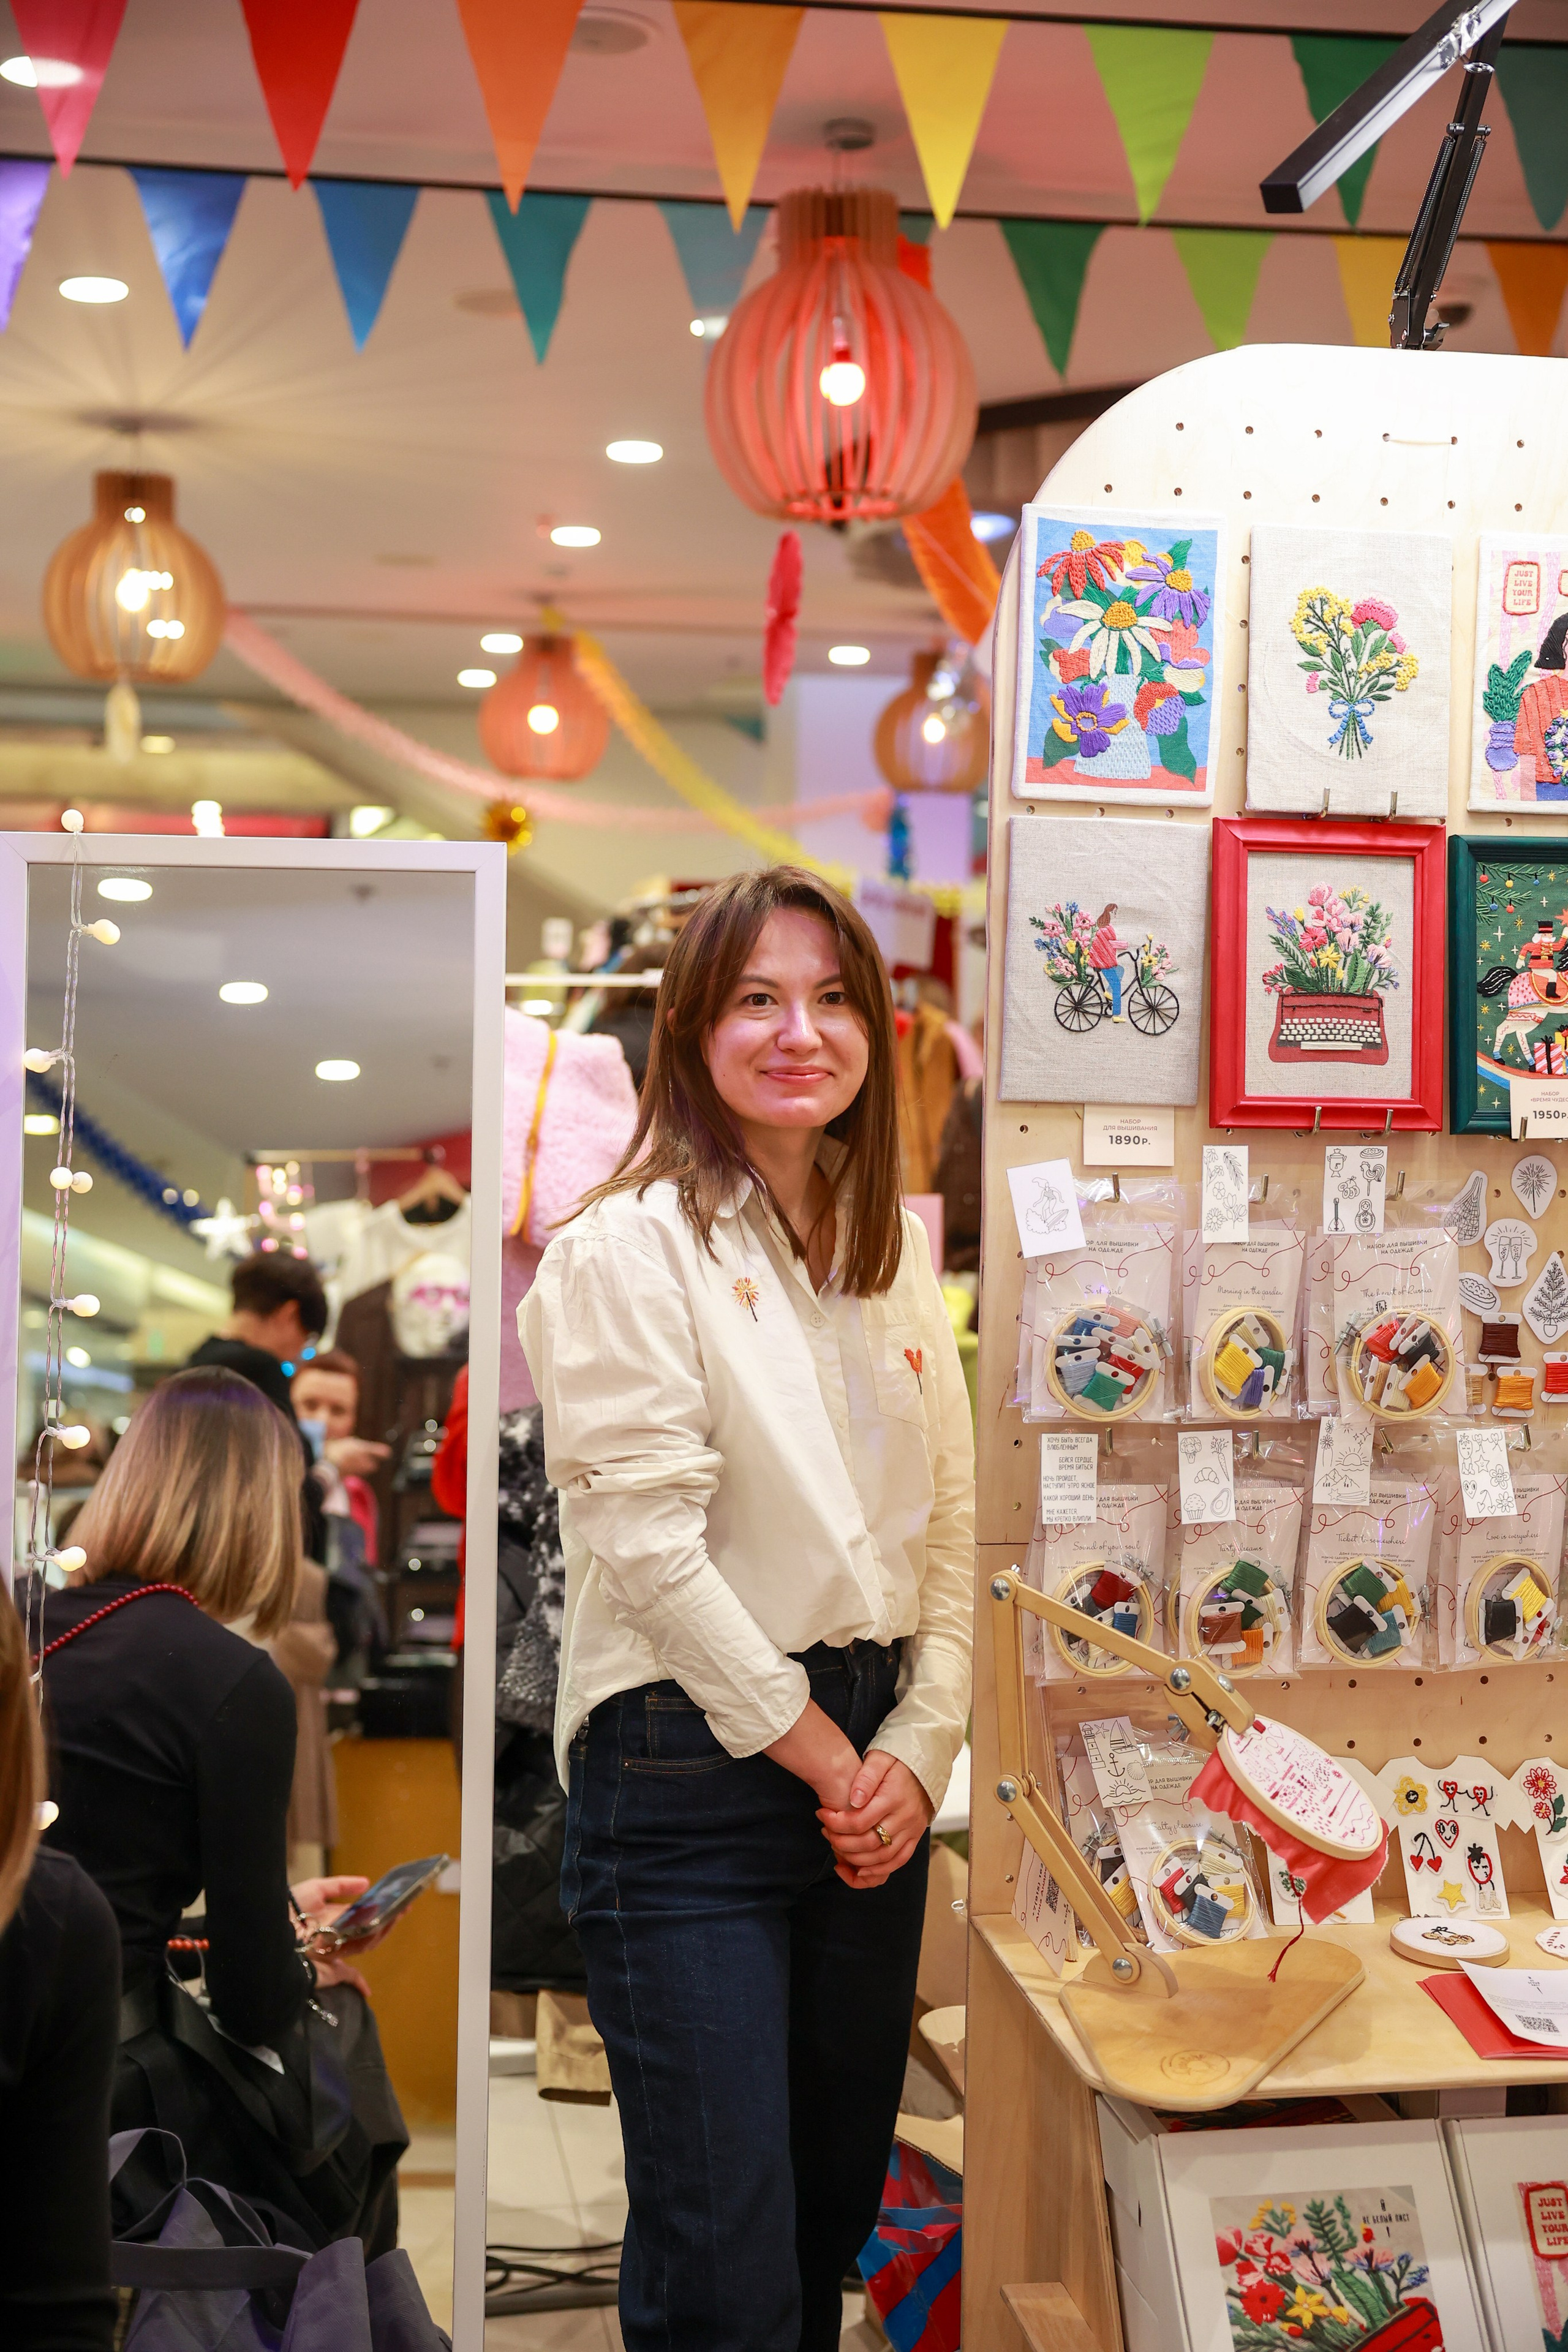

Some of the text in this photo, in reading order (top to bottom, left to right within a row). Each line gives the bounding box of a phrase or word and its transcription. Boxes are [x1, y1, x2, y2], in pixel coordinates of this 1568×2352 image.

[1084, 1284, 1123, 1297] Surf girl
[1217, 1286, 1243, 1300] Morning
[1250, 1286, 1261, 1294] the
[1261, 1286, 1284, 1300] garden
[1360, 1288, 1376, 1298] The
[1398, 1286, 1408, 1295] of
[1336, 1533, 1357, 1542] Ticket
[1370, 1536, 1407, 1545] somewhere
[1486, 1531, 1501, 1540] Love
[1508, 1530, 1540, 1544] everywhere
[1072, 1540, 1098, 1551] Sound
[1099, 1540, 1108, 1551] of
[1125, 1540, 1141, 1550] soul
[1218, 1543, 1237, 1557] Tasty
[1171, 1820, 1204, 1834] pleasure
[1537, 2197, 1562, 2207] JUST
[1362, 2213, 1409, 2224] НЕ БЕЛЫЙ ЛИСТ
[1540, 2211, 1565, 2220] LIVE
[1542, 2223, 1568, 2234] YOUR
[1547, 2236, 1568, 2246] LIFE
